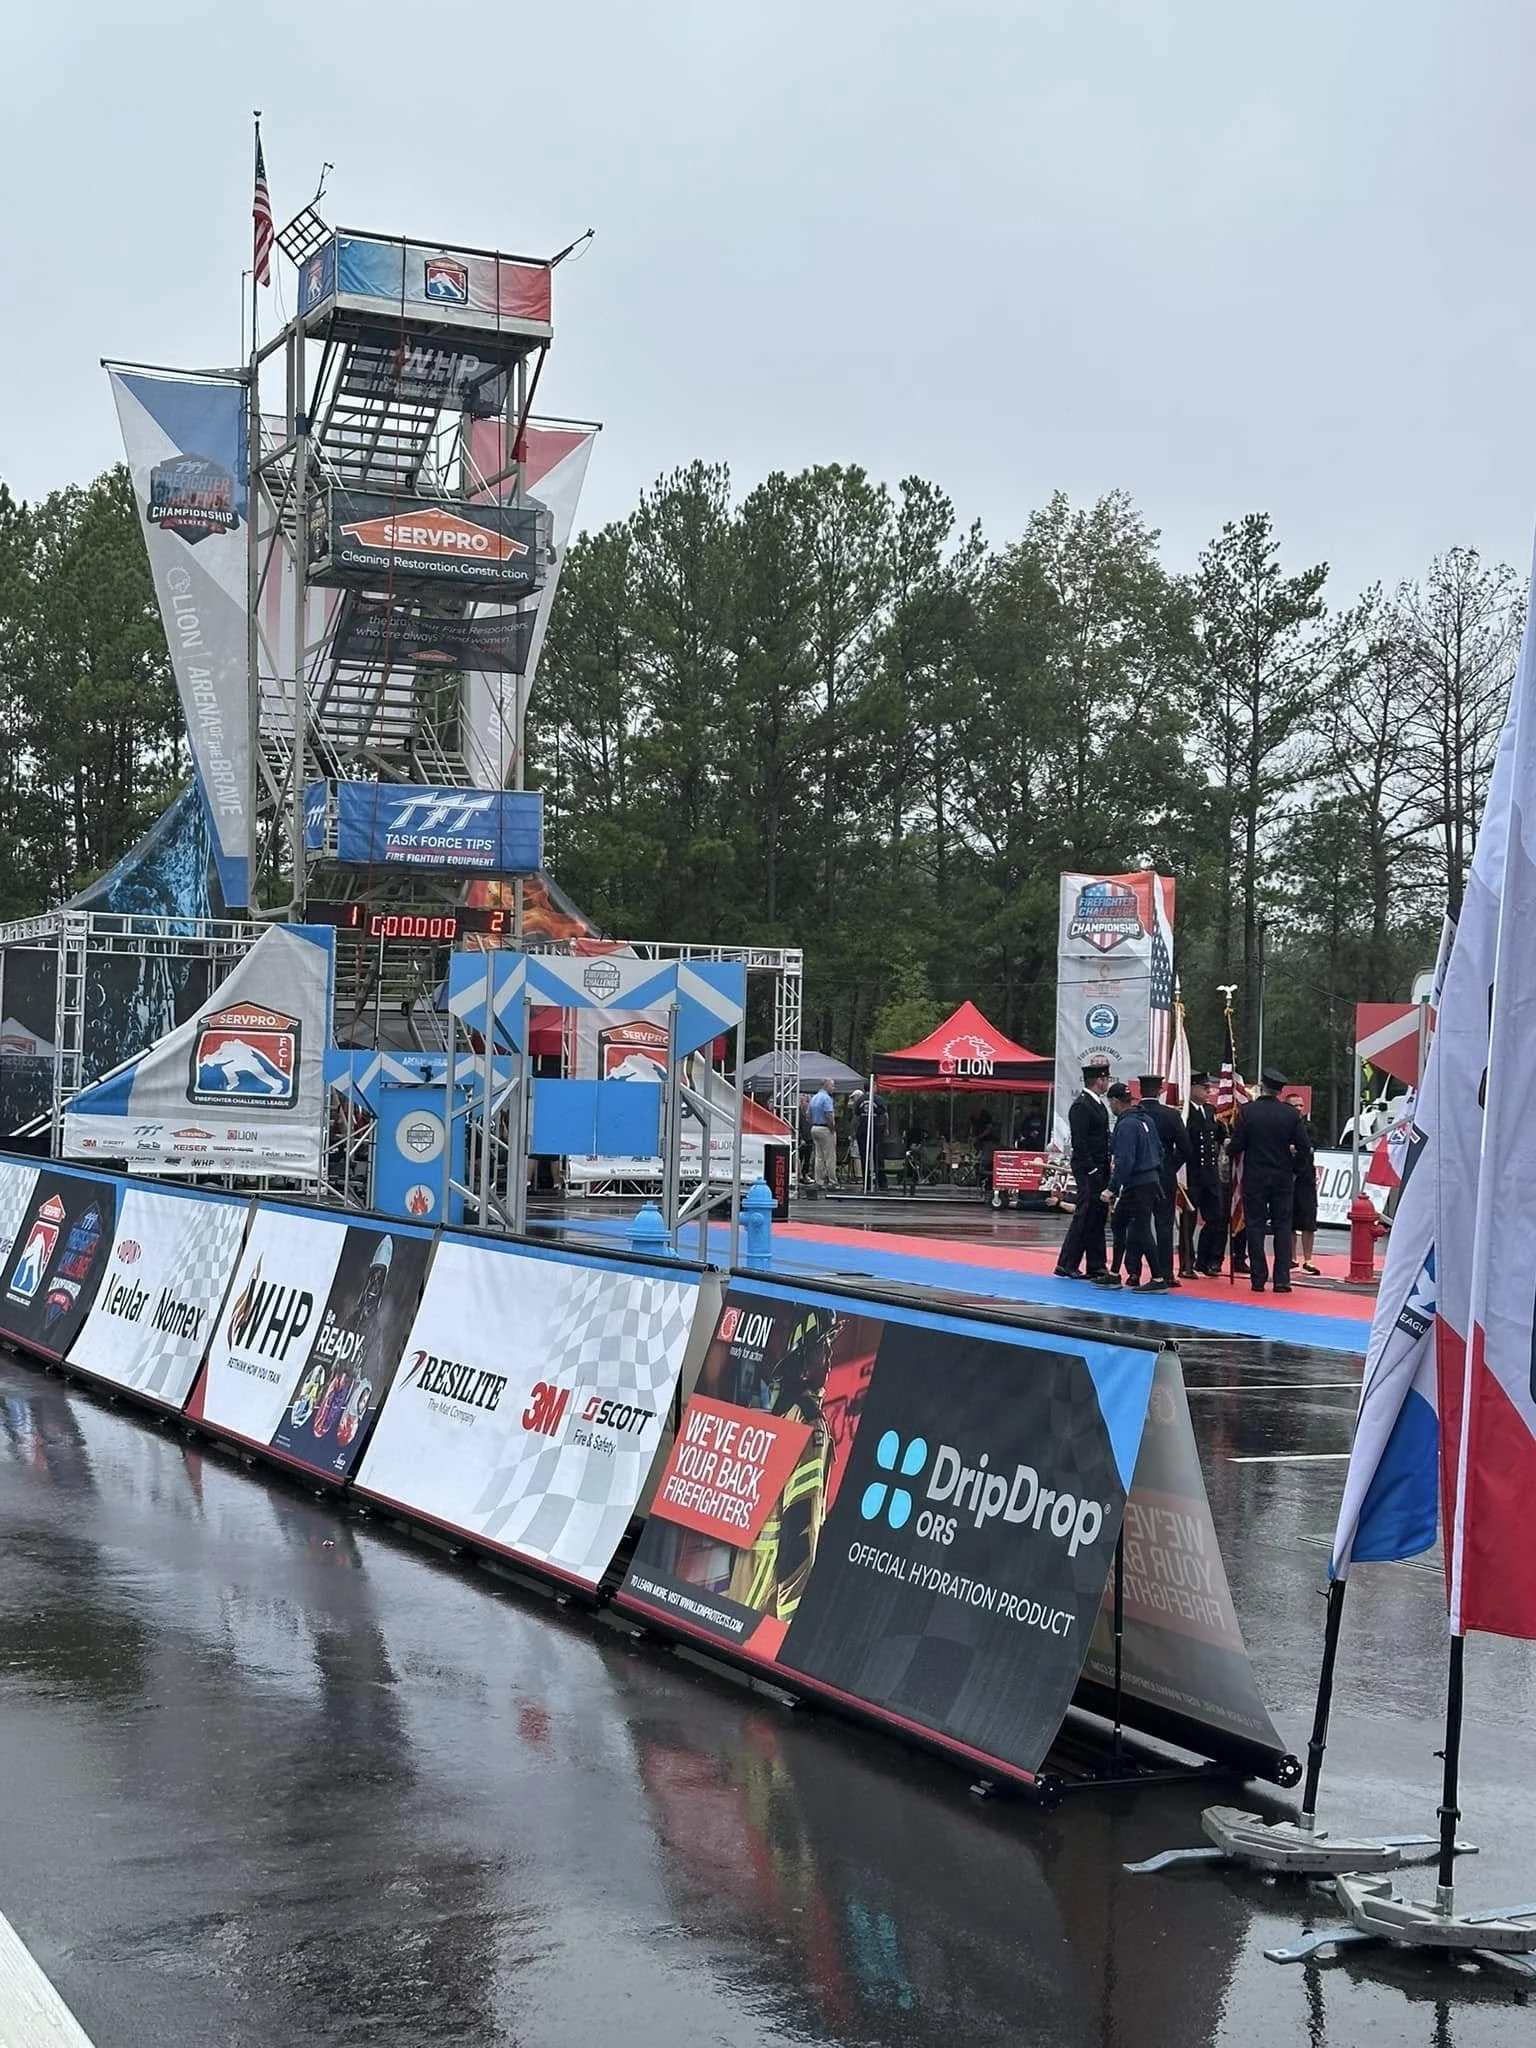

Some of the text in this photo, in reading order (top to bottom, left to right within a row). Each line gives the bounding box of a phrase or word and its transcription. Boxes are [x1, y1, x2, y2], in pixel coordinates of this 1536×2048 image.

[152, 506, 234, 523] CHAMPIONSHIP
[383, 525, 489, 551] SERVPRO
[172, 594, 203, 648] LION
[187, 666, 223, 727] ARENA
[210, 758, 243, 816] BRAVE
[385, 834, 493, 850] TASK FORCE TIPS
[385, 852, 495, 867] FIRE FIGHTING EQUIPMENT
[491, 911, 504, 932] 2
[1071, 923, 1140, 936] CHAMPIONSHIP
[585, 979, 619, 987] CHALLENGE
[220, 1014, 276, 1026] SERVPRO
[957, 1060, 994, 1076] LION
[82, 1139, 97, 1147] 3M
[173, 1144, 208, 1152] KEISER
[237, 1131, 258, 1141] LION
[193, 1159, 215, 1167] WHP
[100, 1272, 150, 1324] Kevlar
[151, 1287, 206, 1341] Nomex
[235, 1278, 314, 1361] WHP
[315, 1324, 366, 1363] READY
[734, 1311, 774, 1348] LION
[416, 1355, 508, 1412] RESILITE
[522, 1381, 570, 1438] 3M
[596, 1400, 654, 1436] SCOTT
[573, 1429, 587, 1445] Fire
[593, 1435, 617, 1458] Safety
[685, 1410, 777, 1465] WE'VE GOT
[675, 1443, 765, 1507] YOUR BACK,
[663, 1475, 754, 1530] FIREFIGHTERS.
[926, 1444, 1103, 1558] DripDrop
[916, 1510, 958, 1546] ORS
[631, 1575, 640, 1588] TO
[637, 1577, 654, 1594] LEARN
[848, 1542, 1076, 1638] OFFICIAL HYDRATION PRODUCT
